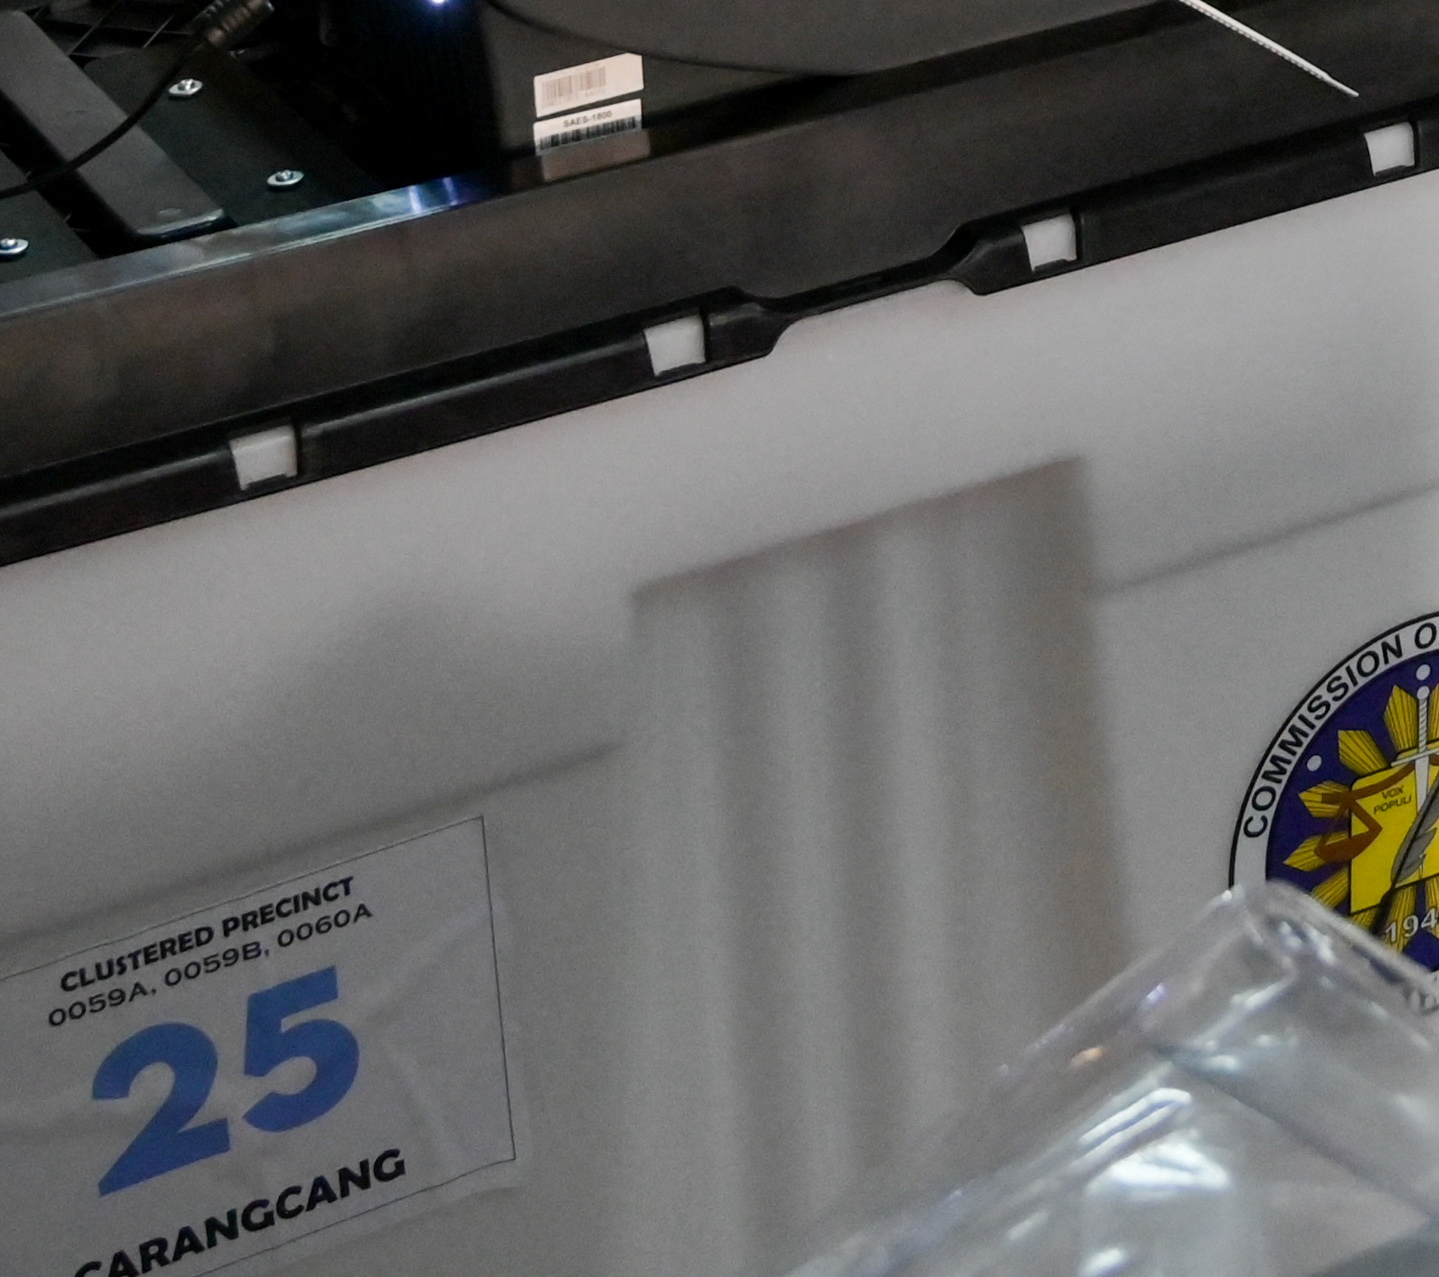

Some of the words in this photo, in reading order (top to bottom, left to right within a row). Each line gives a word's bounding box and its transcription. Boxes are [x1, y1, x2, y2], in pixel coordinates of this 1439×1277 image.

[564, 111, 613, 128] SAES-1800
[1243, 633, 1403, 839] COMMISSION
[1373, 795, 1413, 816] POPULI
[1381, 784, 1405, 800] VOX
[60, 925, 215, 992] CLUSTERED
[220, 875, 355, 940] PRECINCT
[275, 903, 374, 948] 0060A
[91, 965, 361, 1199] 25
